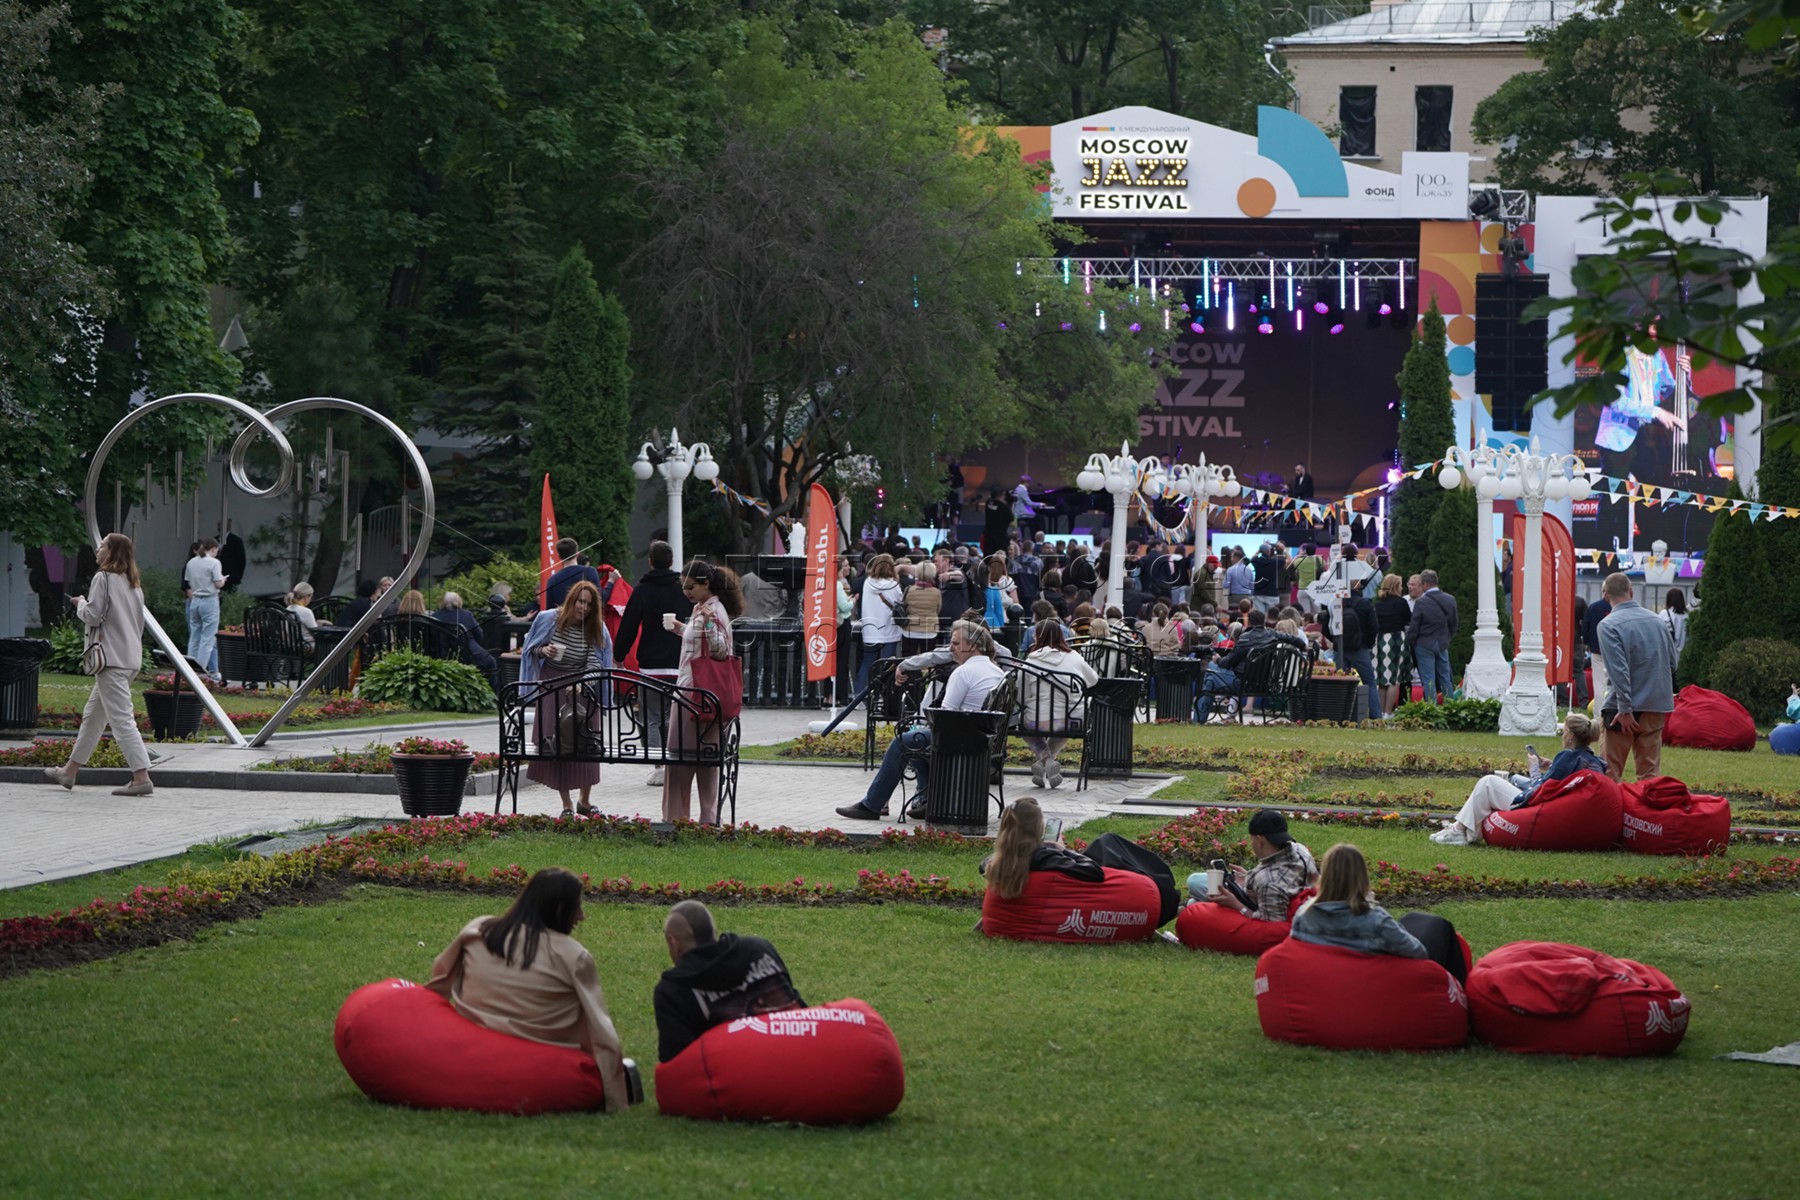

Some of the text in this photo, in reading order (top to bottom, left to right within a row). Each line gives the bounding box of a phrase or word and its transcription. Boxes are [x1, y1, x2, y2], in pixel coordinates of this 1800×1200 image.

[1081, 139, 1188, 154] MOSCOW
[1080, 158, 1188, 187] JAZZ
[1365, 187, 1395, 196] ФОНД
[1080, 194, 1188, 209] FESTIVAL
[1137, 415, 1242, 437] STIVAL
[1090, 910, 1148, 926] МОСКОВСКИЙ
[1085, 925, 1118, 939] СПОРТ
[770, 1020, 818, 1037] СПОРТ
